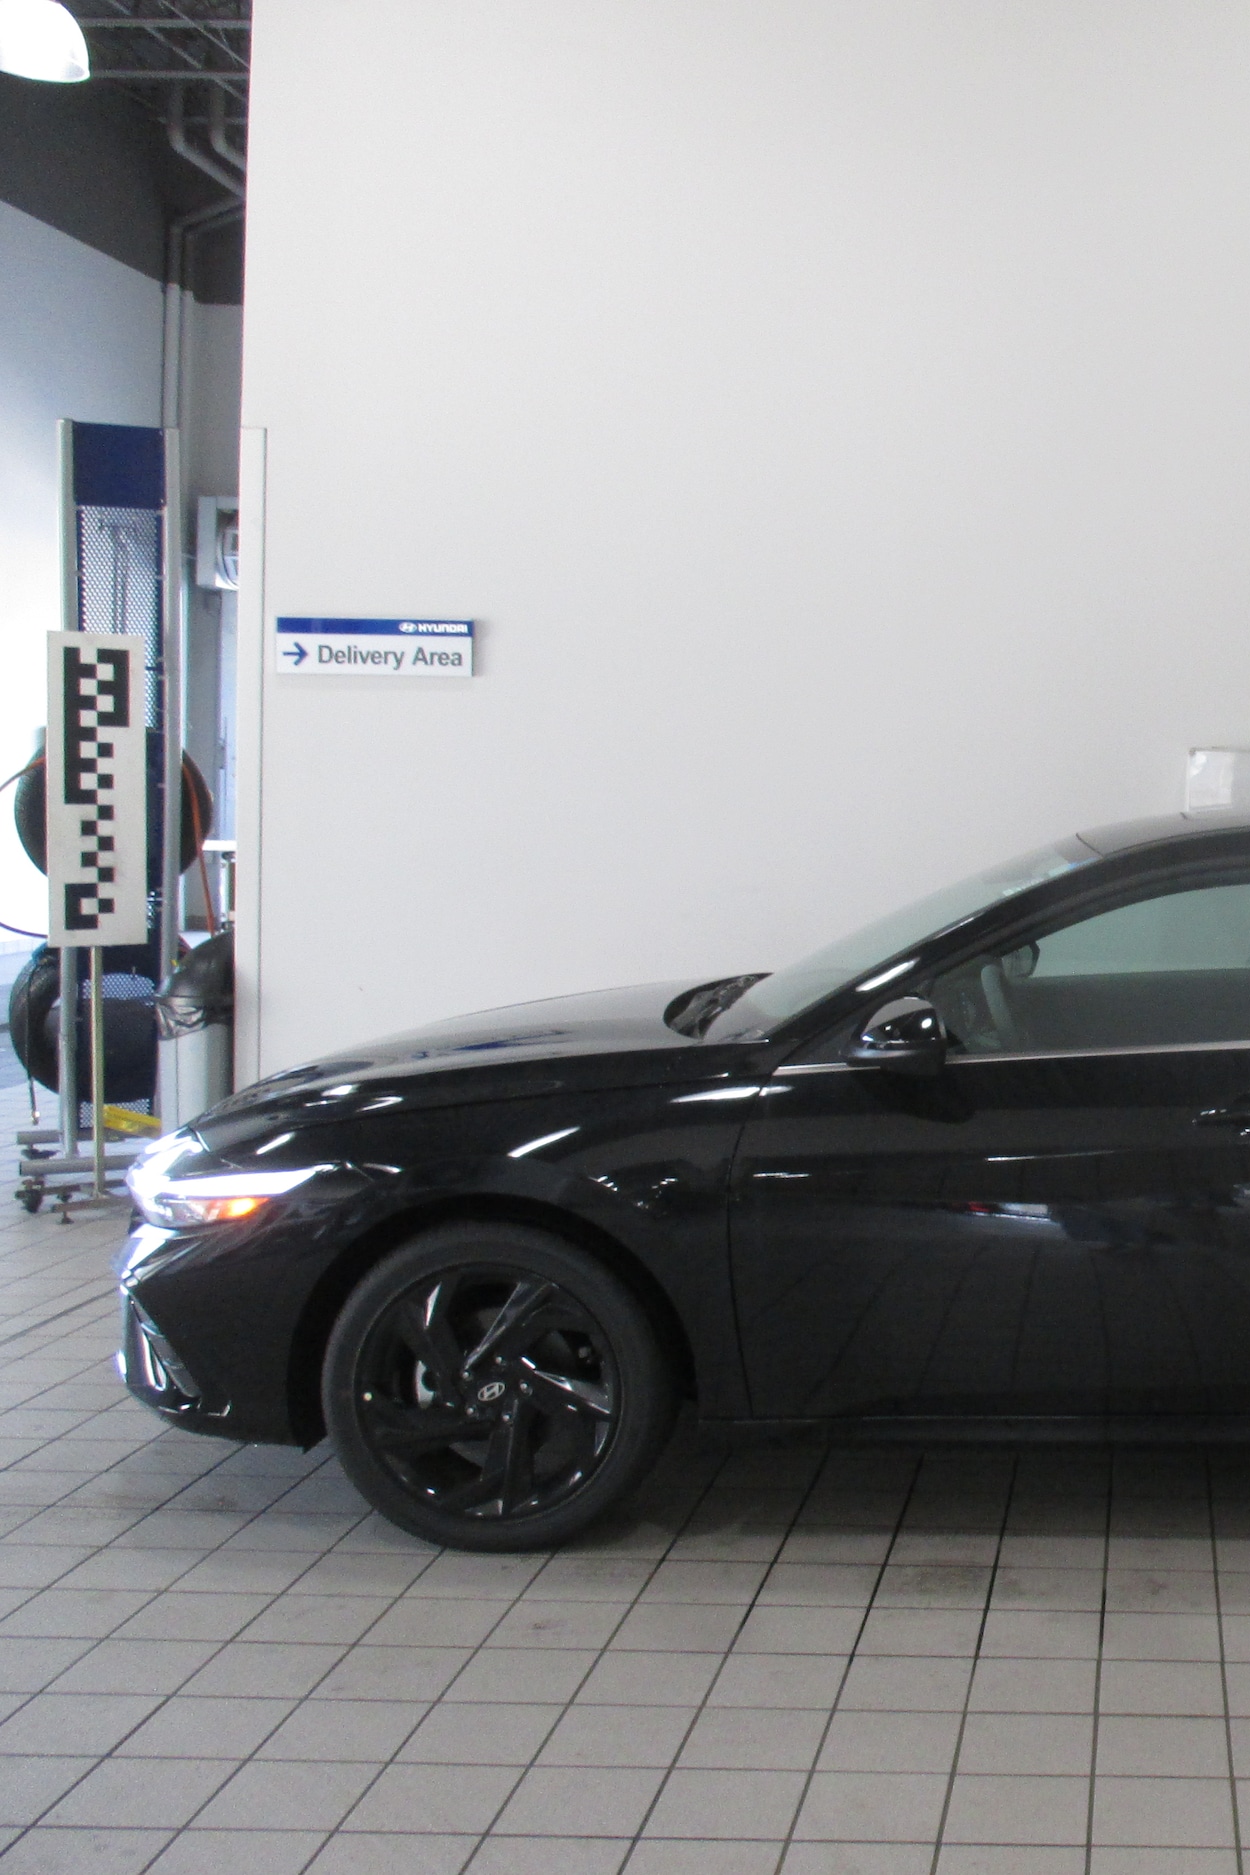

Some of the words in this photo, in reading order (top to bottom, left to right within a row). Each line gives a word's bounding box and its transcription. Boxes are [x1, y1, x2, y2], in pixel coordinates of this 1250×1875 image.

[418, 623, 468, 633] HYUNDAI
[317, 645, 405, 670] Delivery
[412, 647, 462, 666] Area
